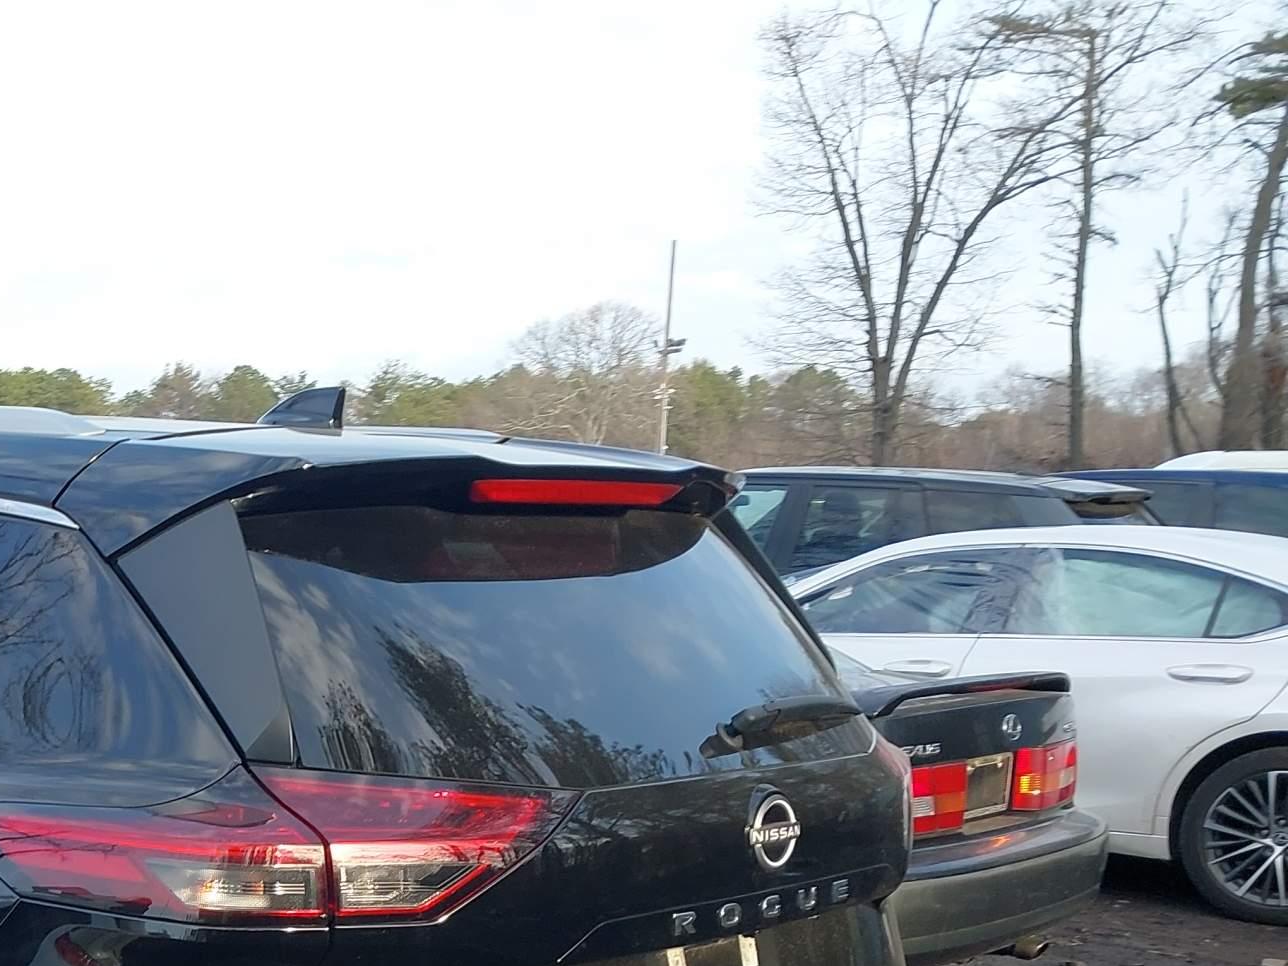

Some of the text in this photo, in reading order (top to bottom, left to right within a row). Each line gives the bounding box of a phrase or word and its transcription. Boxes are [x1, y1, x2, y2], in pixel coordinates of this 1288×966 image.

[902, 742, 942, 758] EXUS
[751, 824, 801, 844] NISSAN
[673, 878, 850, 937] ROGUE
